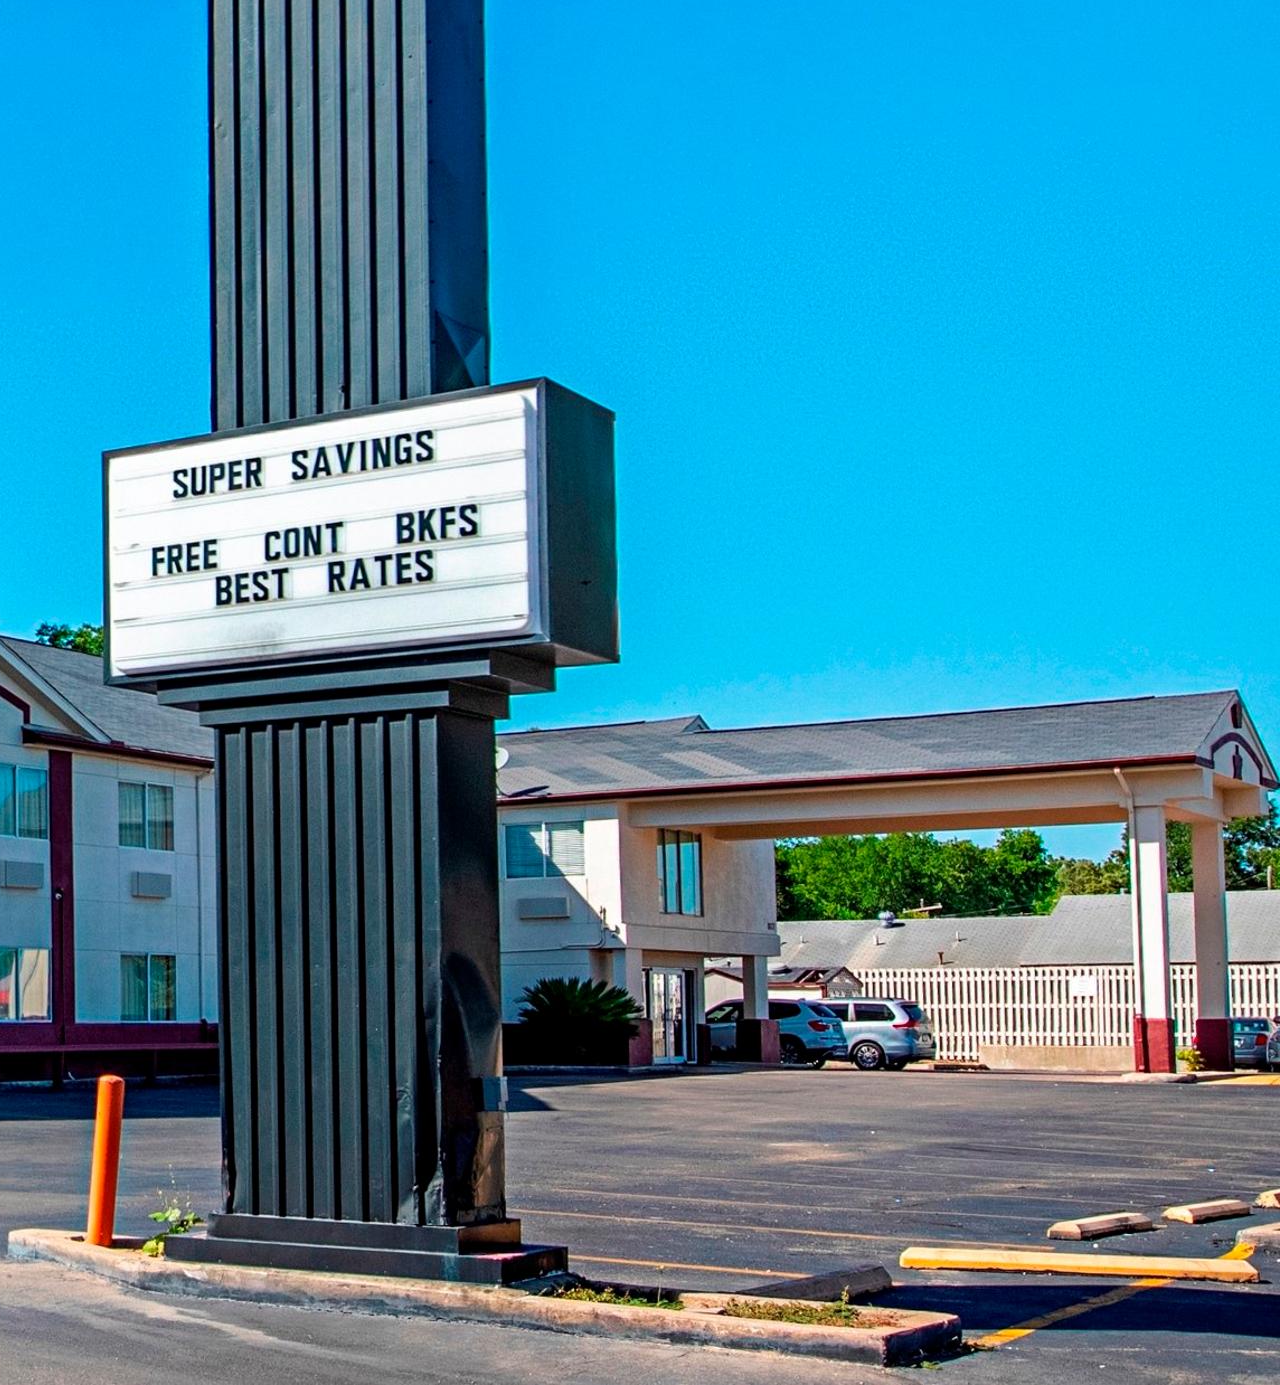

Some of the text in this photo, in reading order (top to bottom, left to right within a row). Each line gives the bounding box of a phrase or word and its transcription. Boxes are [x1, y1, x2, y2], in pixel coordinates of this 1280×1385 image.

[173, 429, 434, 499] SUPER SAVINGS
[151, 503, 478, 576] FREE CONT BKFS
[215, 549, 434, 606] BEST RATES
